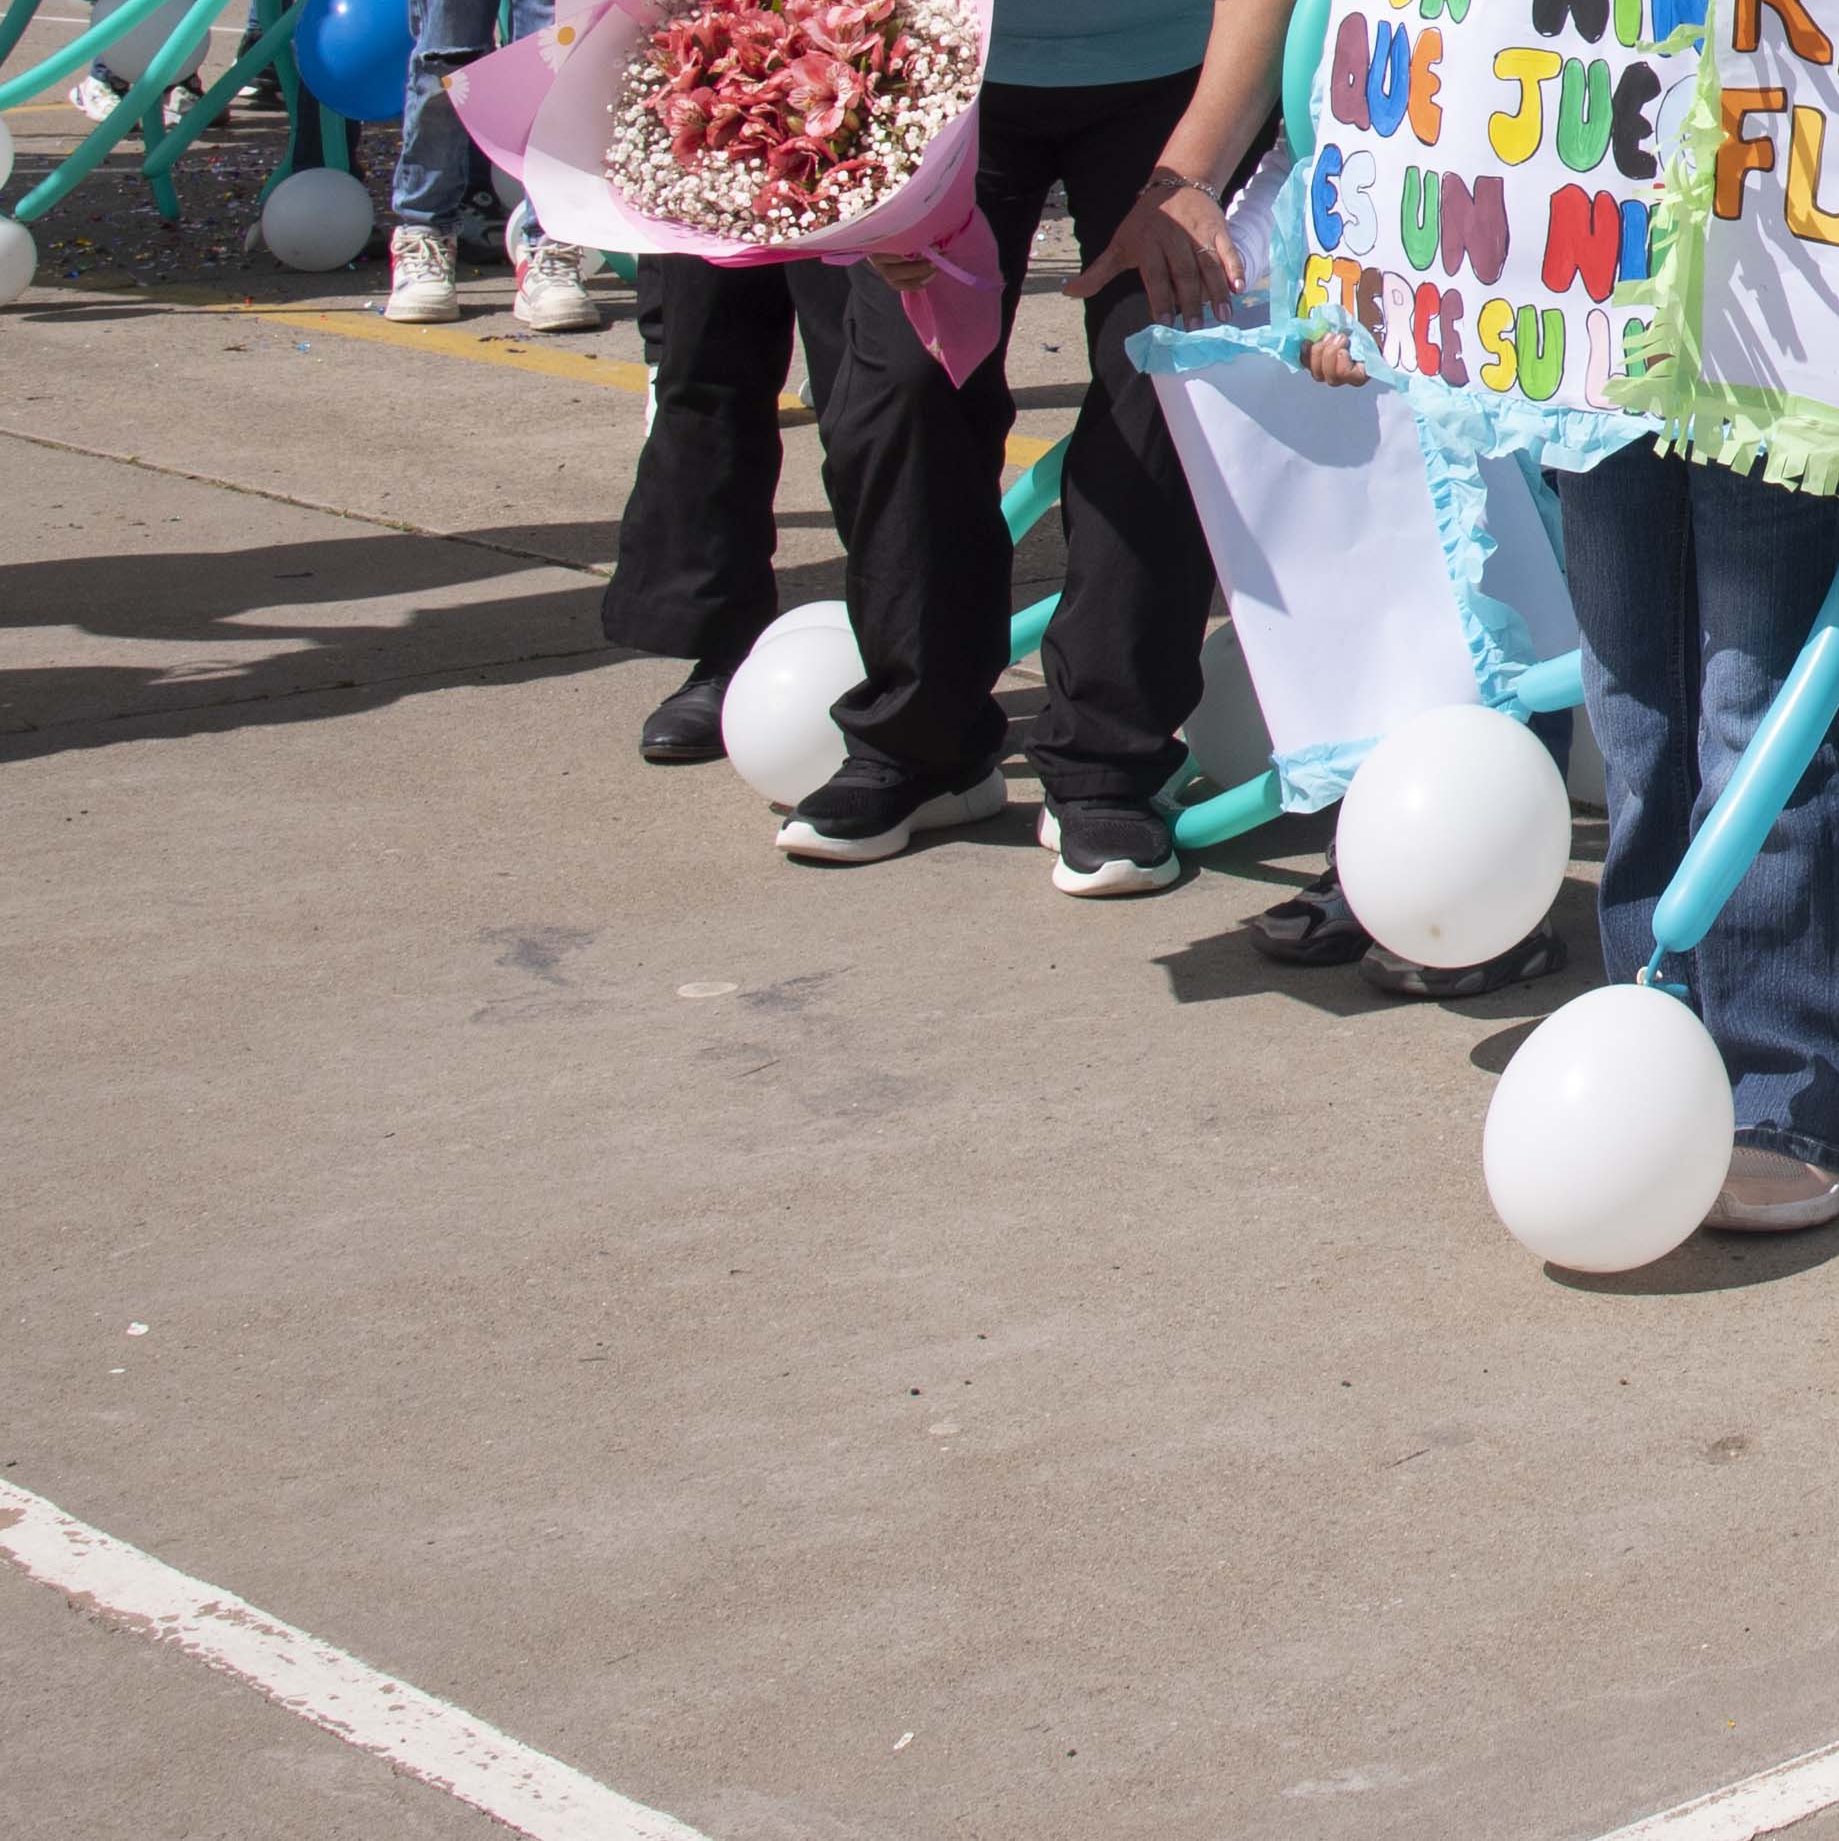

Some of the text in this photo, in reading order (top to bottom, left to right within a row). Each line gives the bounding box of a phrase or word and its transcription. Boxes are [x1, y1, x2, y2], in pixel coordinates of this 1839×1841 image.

[1331, 12, 1443, 146] QUE
[1310, 143, 1376, 255] ES
[1401, 166, 1510, 284] UN
[1477, 298, 1565, 400] SU
